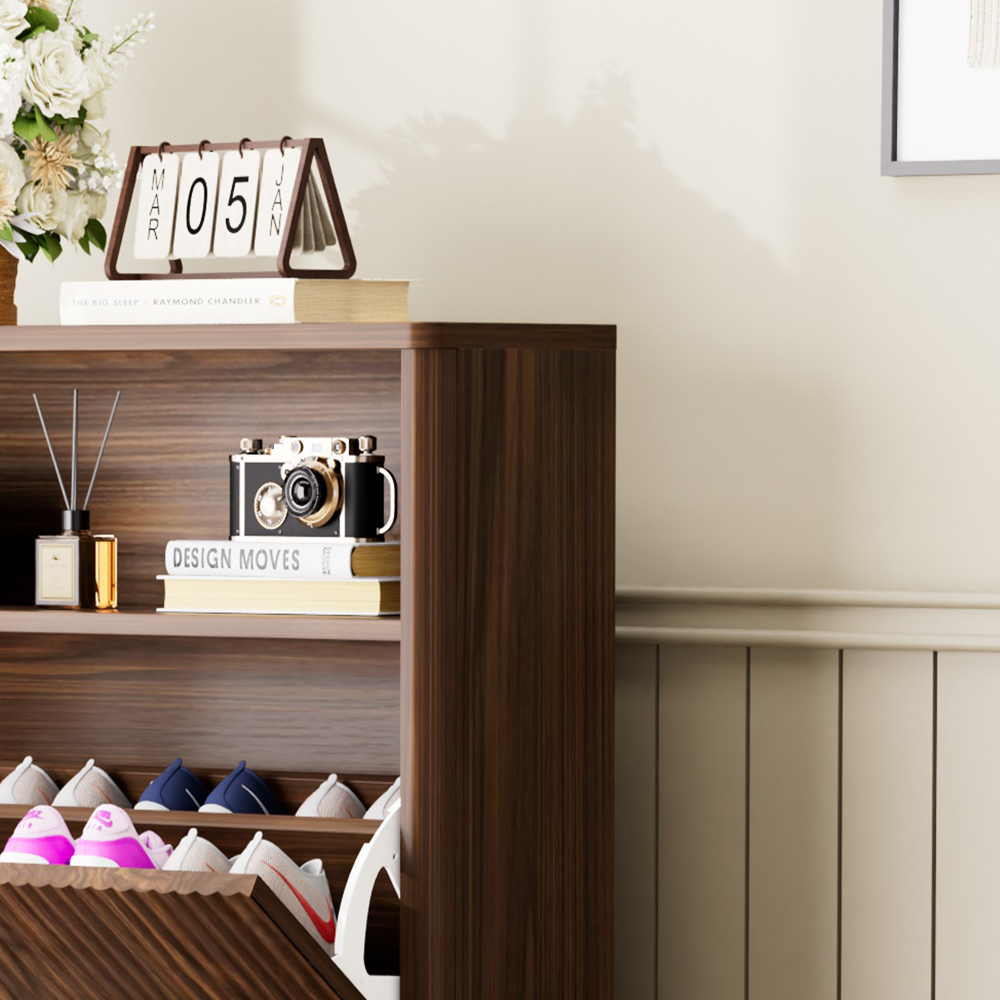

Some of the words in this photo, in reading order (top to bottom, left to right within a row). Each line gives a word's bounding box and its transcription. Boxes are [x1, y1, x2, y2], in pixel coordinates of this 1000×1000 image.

[147, 168, 165, 240] MAR
[269, 163, 284, 236] JAN
[71, 299, 89, 307] THE
[92, 299, 110, 307] BIG
[113, 298, 140, 307] SLEEP
[153, 298, 204, 306] RAYMOND
[207, 297, 261, 305] CHANDLER
[173, 547, 232, 569] DESIGN
[239, 549, 300, 571] MOVES
